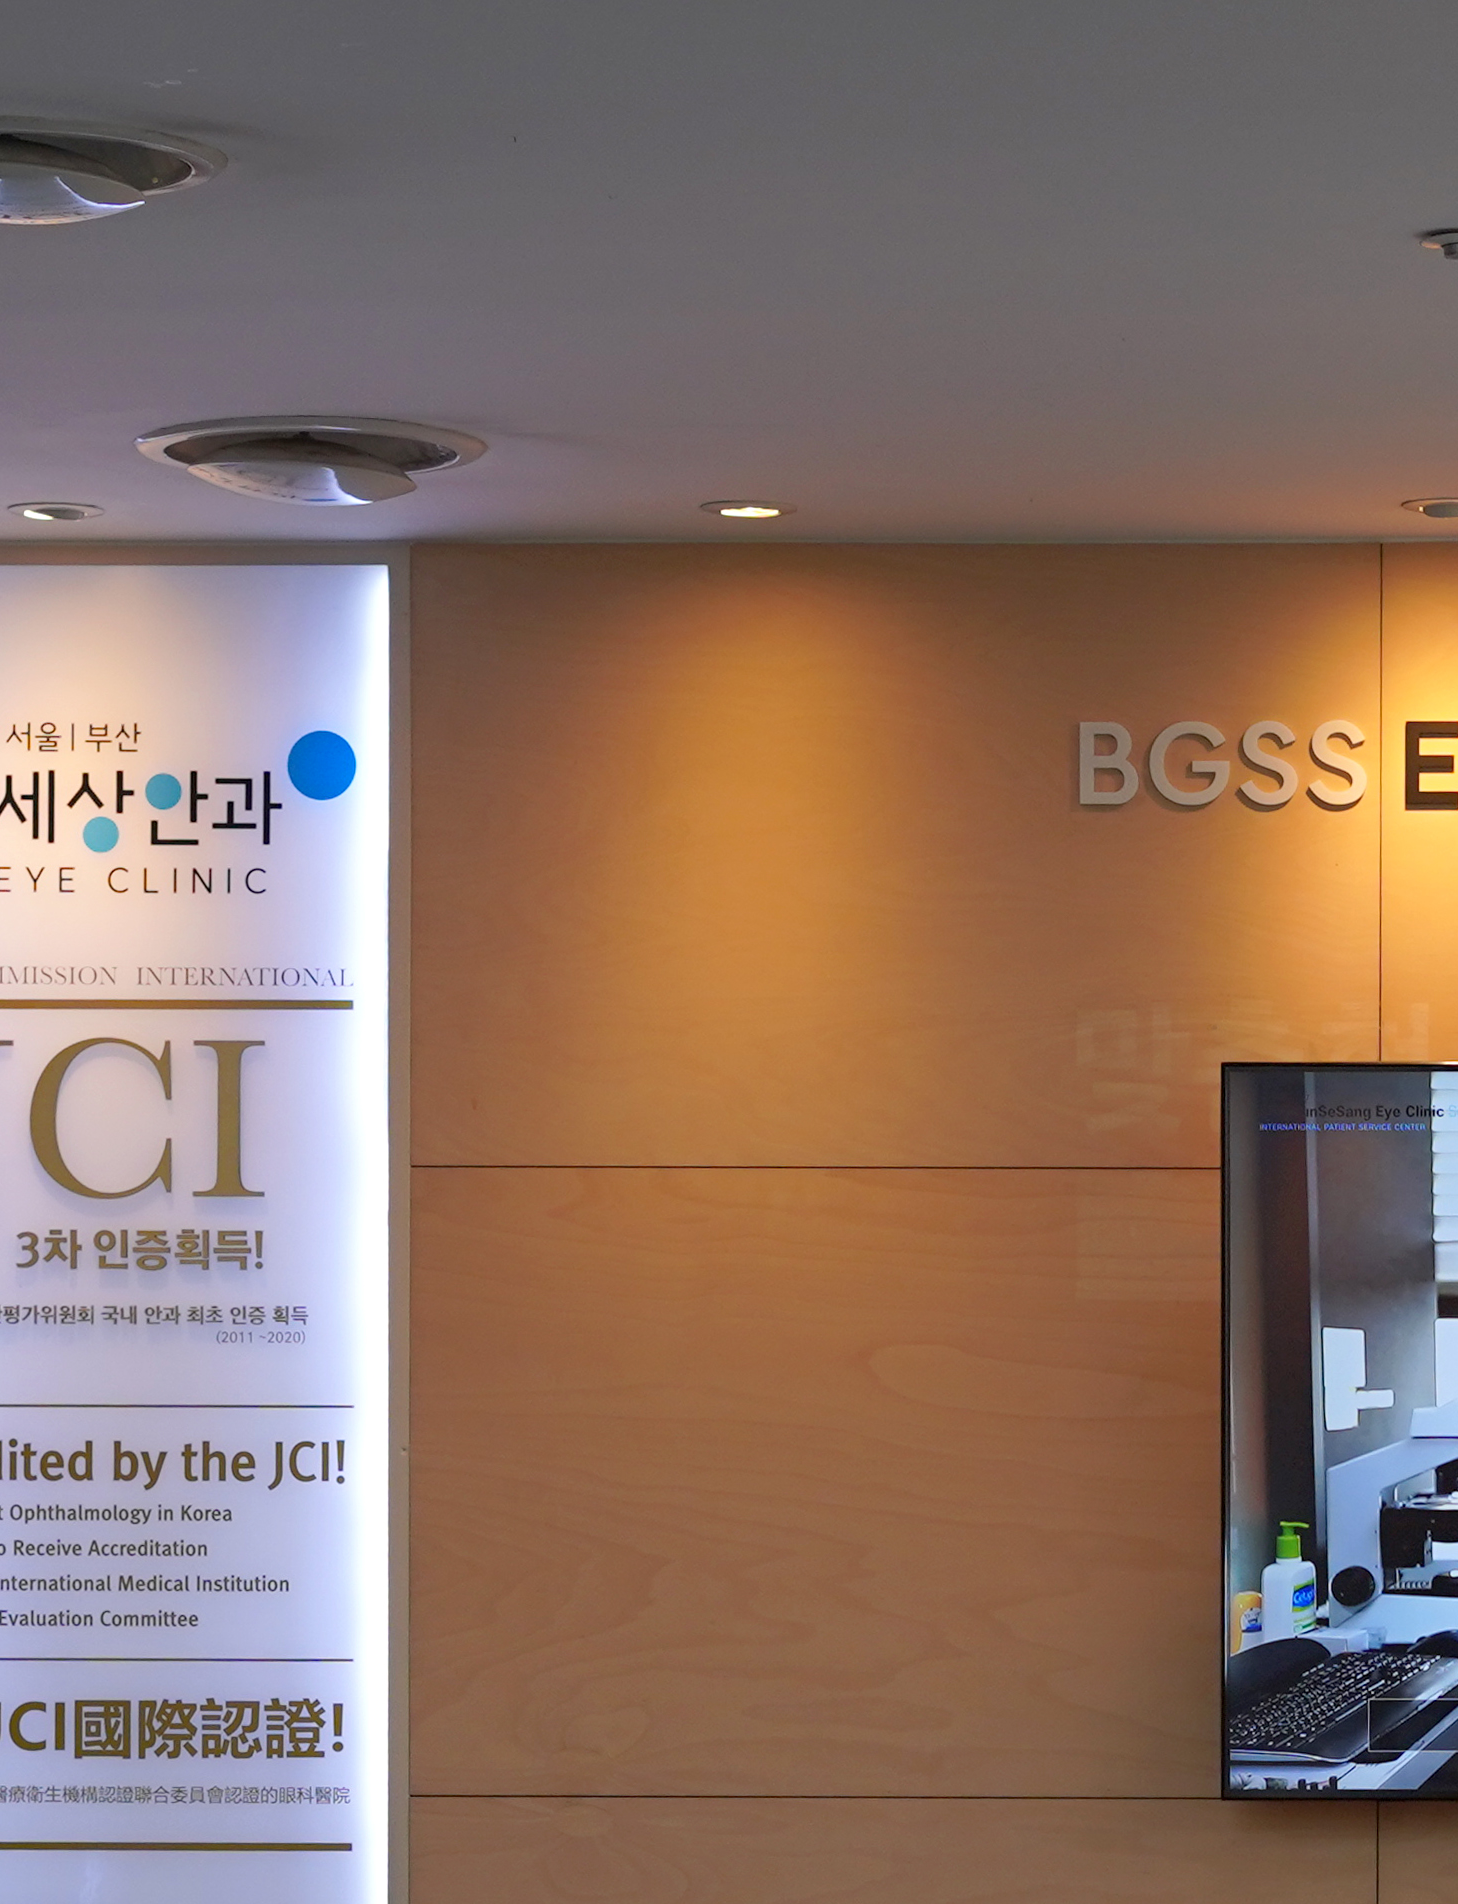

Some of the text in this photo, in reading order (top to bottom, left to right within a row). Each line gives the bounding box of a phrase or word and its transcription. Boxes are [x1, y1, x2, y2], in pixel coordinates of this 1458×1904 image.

[5, 721, 62, 753] 서울
[84, 722, 142, 753] 부산
[1077, 719, 1368, 811] BGSS
[107, 866, 267, 895] CLINIC
[137, 967, 354, 987] INTERNATIONAL
[1375, 1104, 1402, 1120] Eye
[1405, 1103, 1445, 1119] Clinic
[15, 1228, 264, 1272] 3차 인증획득!
[100, 1305, 138, 1326] 국내
[144, 1305, 182, 1326] 안과
[186, 1305, 224, 1326] 최초
[229, 1305, 267, 1326] 인증
[271, 1305, 309, 1327] 획득
[112, 1440, 168, 1491] by
[180, 1440, 256, 1483] the
[267, 1439, 346, 1491] JCI!
[9, 1503, 152, 1525] Ophthalmology
[157, 1503, 174, 1522] in
[180, 1504, 233, 1522] Korea
[13, 1538, 83, 1557] Receive
[87, 1539, 208, 1557] Accreditation
[118, 1574, 190, 1592] Medical
[196, 1574, 290, 1593] Institution
[99, 1609, 199, 1628] Committee
